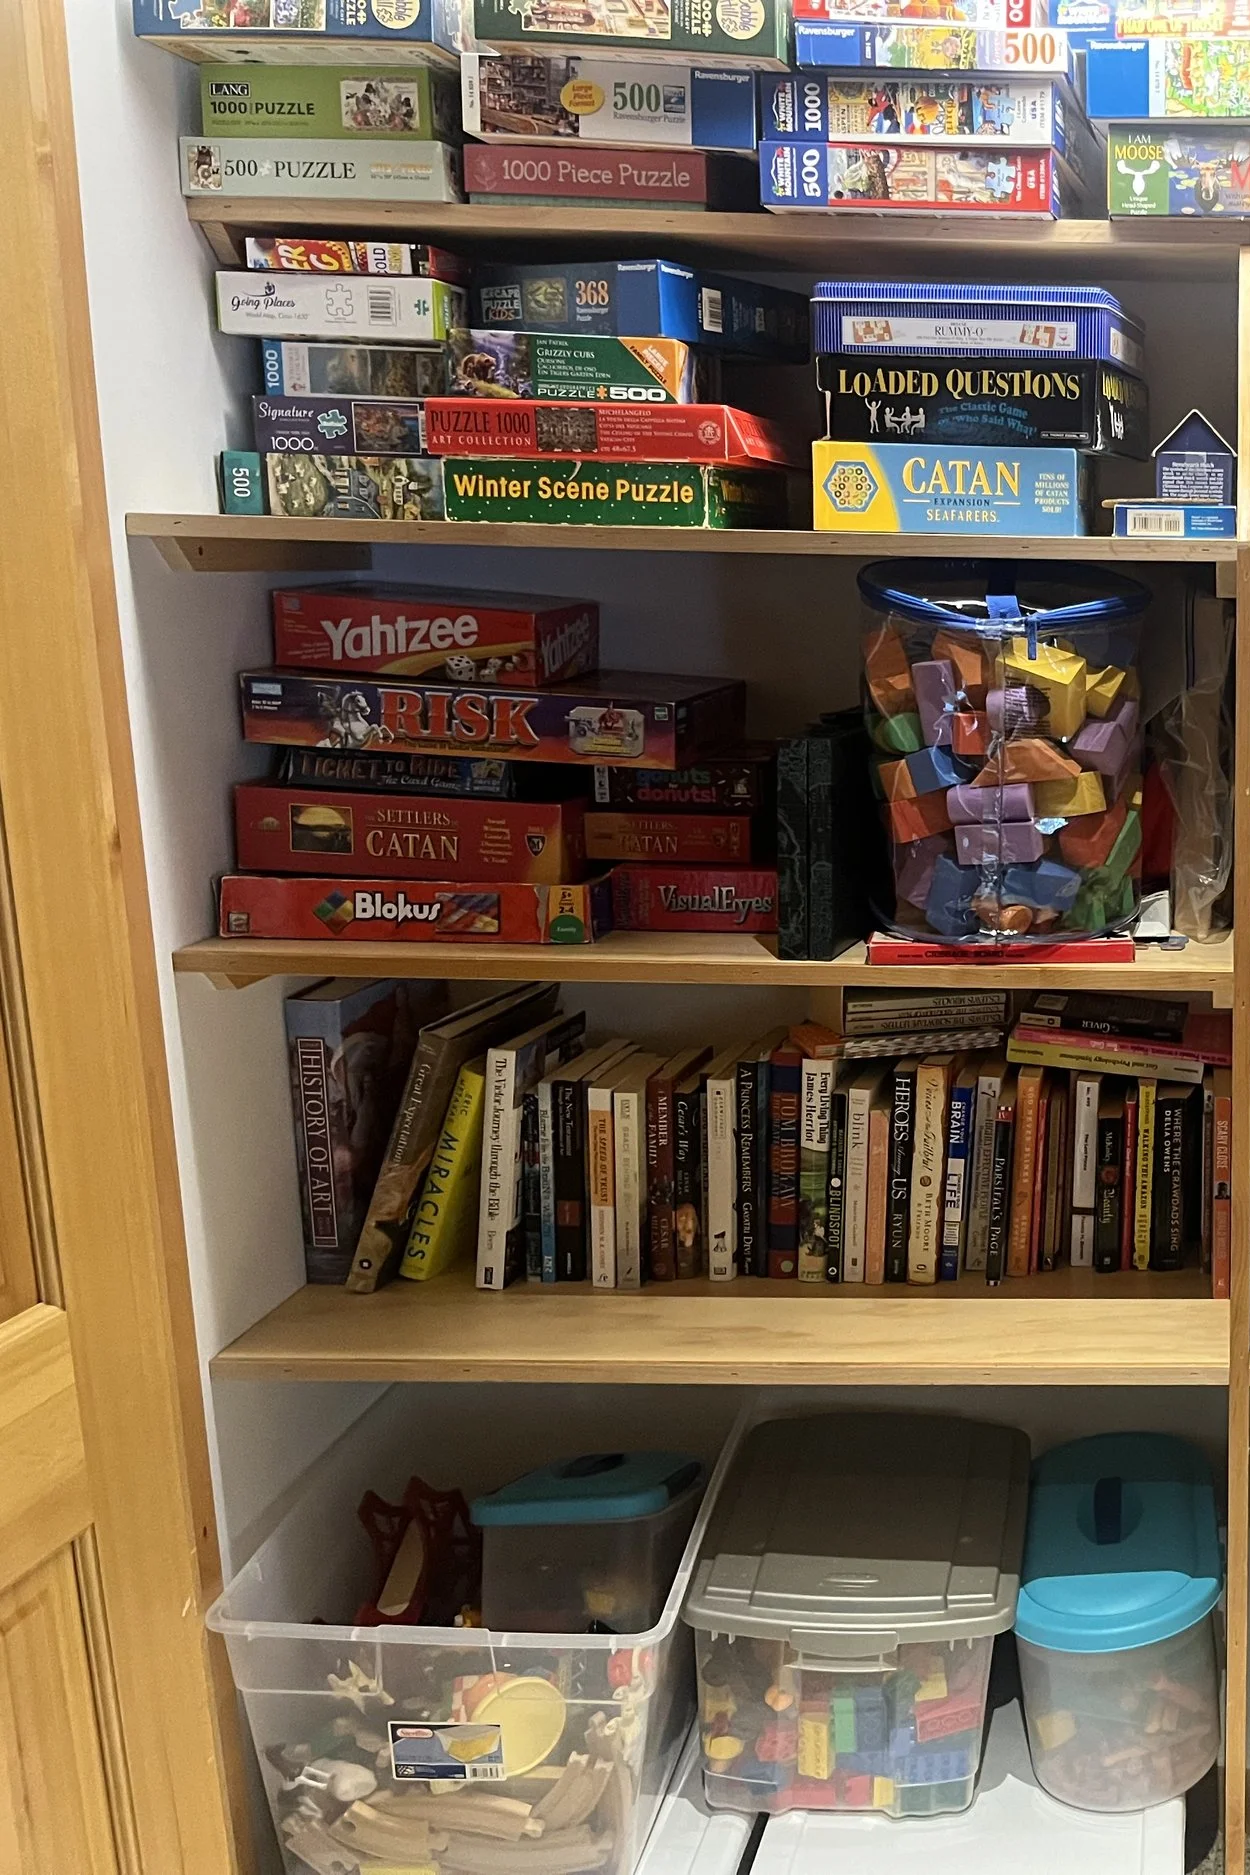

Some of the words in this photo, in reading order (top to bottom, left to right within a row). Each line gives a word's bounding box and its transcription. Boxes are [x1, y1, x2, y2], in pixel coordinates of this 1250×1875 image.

[798, 26, 855, 38] Ravensburger
[1004, 32, 1055, 65] 500
[211, 83, 249, 96] LANG
[694, 70, 750, 84] Ravensburger
[210, 101, 248, 115] 1000
[254, 102, 315, 117] PUZZLE
[613, 82, 661, 114] 500
[777, 87, 785, 116] WHITE
[784, 81, 792, 131] MOUNTAIN
[804, 82, 820, 131] 1000
[613, 112, 661, 123] Ravensburger
[664, 114, 686, 124] Puzzle
[1134, 135, 1151, 143] AM
[1114, 145, 1163, 160] MOOSE
[224, 161, 258, 177] 500
[274, 161, 356, 180] PUZZLE
[502, 161, 552, 181] 1000
[558, 164, 613, 184] Piece
[619, 165, 690, 188] Puzzle
[777, 154, 785, 184] WHITE
[784, 147, 792, 197] MOUNTAIN
[802, 149, 820, 197] 500
[484, 300, 520, 309] PUZZLE
[575, 281, 609, 306] 368
[489, 309, 515, 321] KIDS
[935, 326, 983, 337] RUMMY-O
[537, 348, 571, 358] GRIZZLY
[574, 350, 595, 358] CUBS
[265, 350, 279, 388] 1000
[538, 388, 595, 399] PUZZLE
[610, 387, 666, 401] 500
[838, 367, 939, 397] LOADED
[946, 367, 1081, 400] QUESTIONS
[258, 402, 314, 420] Signature
[431, 411, 491, 433] PUZZLE
[497, 412, 530, 433] 1000
[960, 402, 997, 411] Classic
[999, 403, 1028, 419] Game
[271, 436, 314, 451] 1000
[432, 435, 452, 445] ART
[459, 436, 532, 446] COLLECTION
[232, 467, 250, 498] 500
[453, 473, 531, 498] Winter
[537, 477, 609, 501] Scene
[616, 479, 694, 504] Puzzle
[902, 457, 1021, 497] CATAN
[1035, 481, 1069, 489] MILLIONS
[934, 497, 991, 508] EXPANSION
[1034, 497, 1070, 506] PRODUCTS
[1045, 489, 1069, 497] CATAN
[320, 614, 479, 661] Yahtzee
[377, 688, 540, 747] RISK
[376, 808, 450, 826] SETTLERS
[366, 830, 458, 861] CATAN
[355, 892, 441, 922] Blokus
[558, 905, 574, 914] 2-4
[494, 1059, 507, 1076] The
[740, 1069, 752, 1078] A
[301, 1054, 326, 1136] HISTORY
[805, 1072, 817, 1103] James
[817, 1072, 830, 1094] Every
[981, 1090, 995, 1098] 7
[564, 1103, 573, 1120] New
[740, 1081, 753, 1129] PRINCESS
[780, 1096, 796, 1131] TOM
[818, 1095, 830, 1119] Living
[894, 1078, 911, 1141] HEROES
[489, 1106, 505, 1143] Journey
[599, 1119, 607, 1134] THE
[658, 1096, 667, 1146] MEMBER
[677, 1101, 688, 1136] Cesar's
[805, 1105, 816, 1142] Herriot
[851, 1113, 864, 1149] blink
[950, 1101, 962, 1144] BRAIN
[1024, 1109, 1033, 1142] NEVER
[1173, 1109, 1182, 1144] WHERE
[817, 1121, 829, 1144] Thing
[1141, 1128, 1149, 1162] WALKING
[1216, 1120, 1228, 1145] SCARY
[310, 1147, 329, 1169] OF
[648, 1124, 658, 1168] FAMILY
[676, 1140, 688, 1163] Way
[1172, 1147, 1181, 1166] THE
[1216, 1147, 1228, 1169] CLOSE
[488, 1144, 503, 1180] through
[741, 1133, 753, 1193] REMEMBERS
[779, 1138, 796, 1210] BROKAW
[1141, 1164, 1149, 1178] THE
[313, 1172, 333, 1215] ART
[407, 1130, 461, 1261] MIRACLES
[488, 1182, 500, 1197] the
[599, 1177, 608, 1203] TRUST
[893, 1178, 906, 1199] US
[946, 1173, 958, 1208] LIFE
[1140, 1179, 1148, 1209] AMAZON
[1170, 1169, 1179, 1225] CRAWDADS
[487, 1198, 500, 1221] Bible
[742, 1202, 753, 1234] GAYATRI
[924, 1193, 933, 1217] BETH
[828, 1189, 841, 1249] BLINDSPOT
[892, 1213, 903, 1248] RYUN
[743, 1236, 753, 1255] DEVI
[922, 1219, 931, 1252] MOORE
[989, 1227, 1001, 1256] PAGE
[1170, 1227, 1179, 1252] SING
